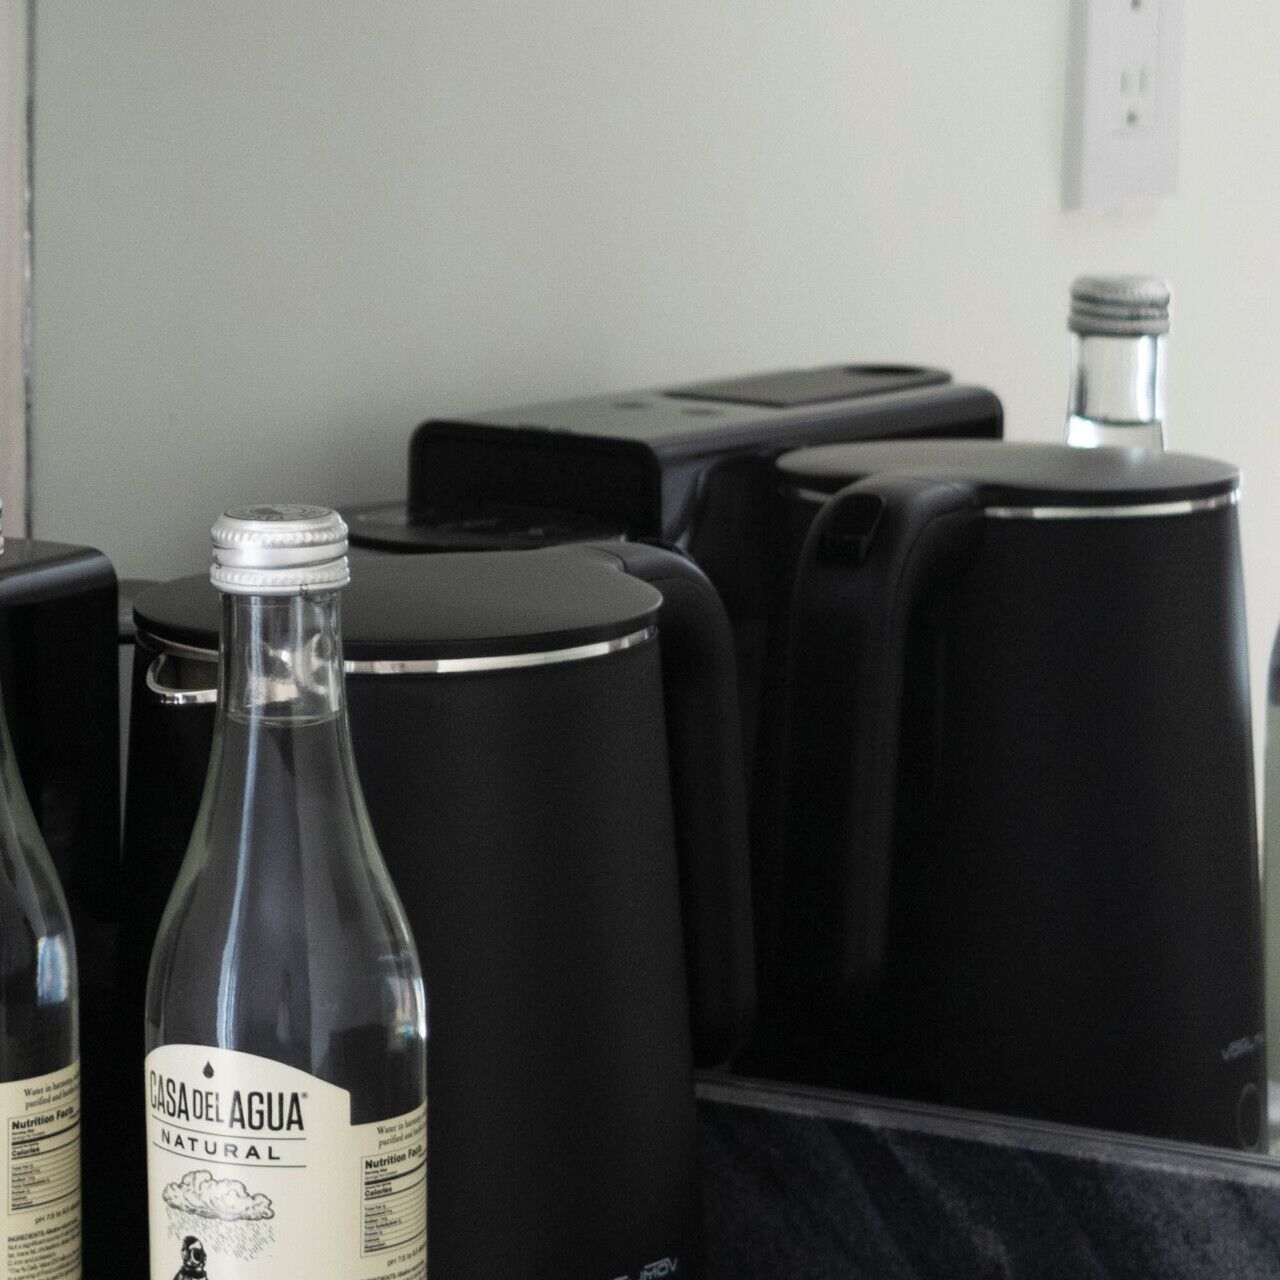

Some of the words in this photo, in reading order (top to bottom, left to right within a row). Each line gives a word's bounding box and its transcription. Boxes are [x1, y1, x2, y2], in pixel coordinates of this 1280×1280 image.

[149, 1070, 189, 1121] CASA
[193, 1088, 224, 1123] DEL
[12, 1114, 54, 1130] Nutrition
[161, 1128, 281, 1160] NATURAL
[365, 1153, 406, 1169] Nutrition
[365, 1186, 392, 1197] Calories
